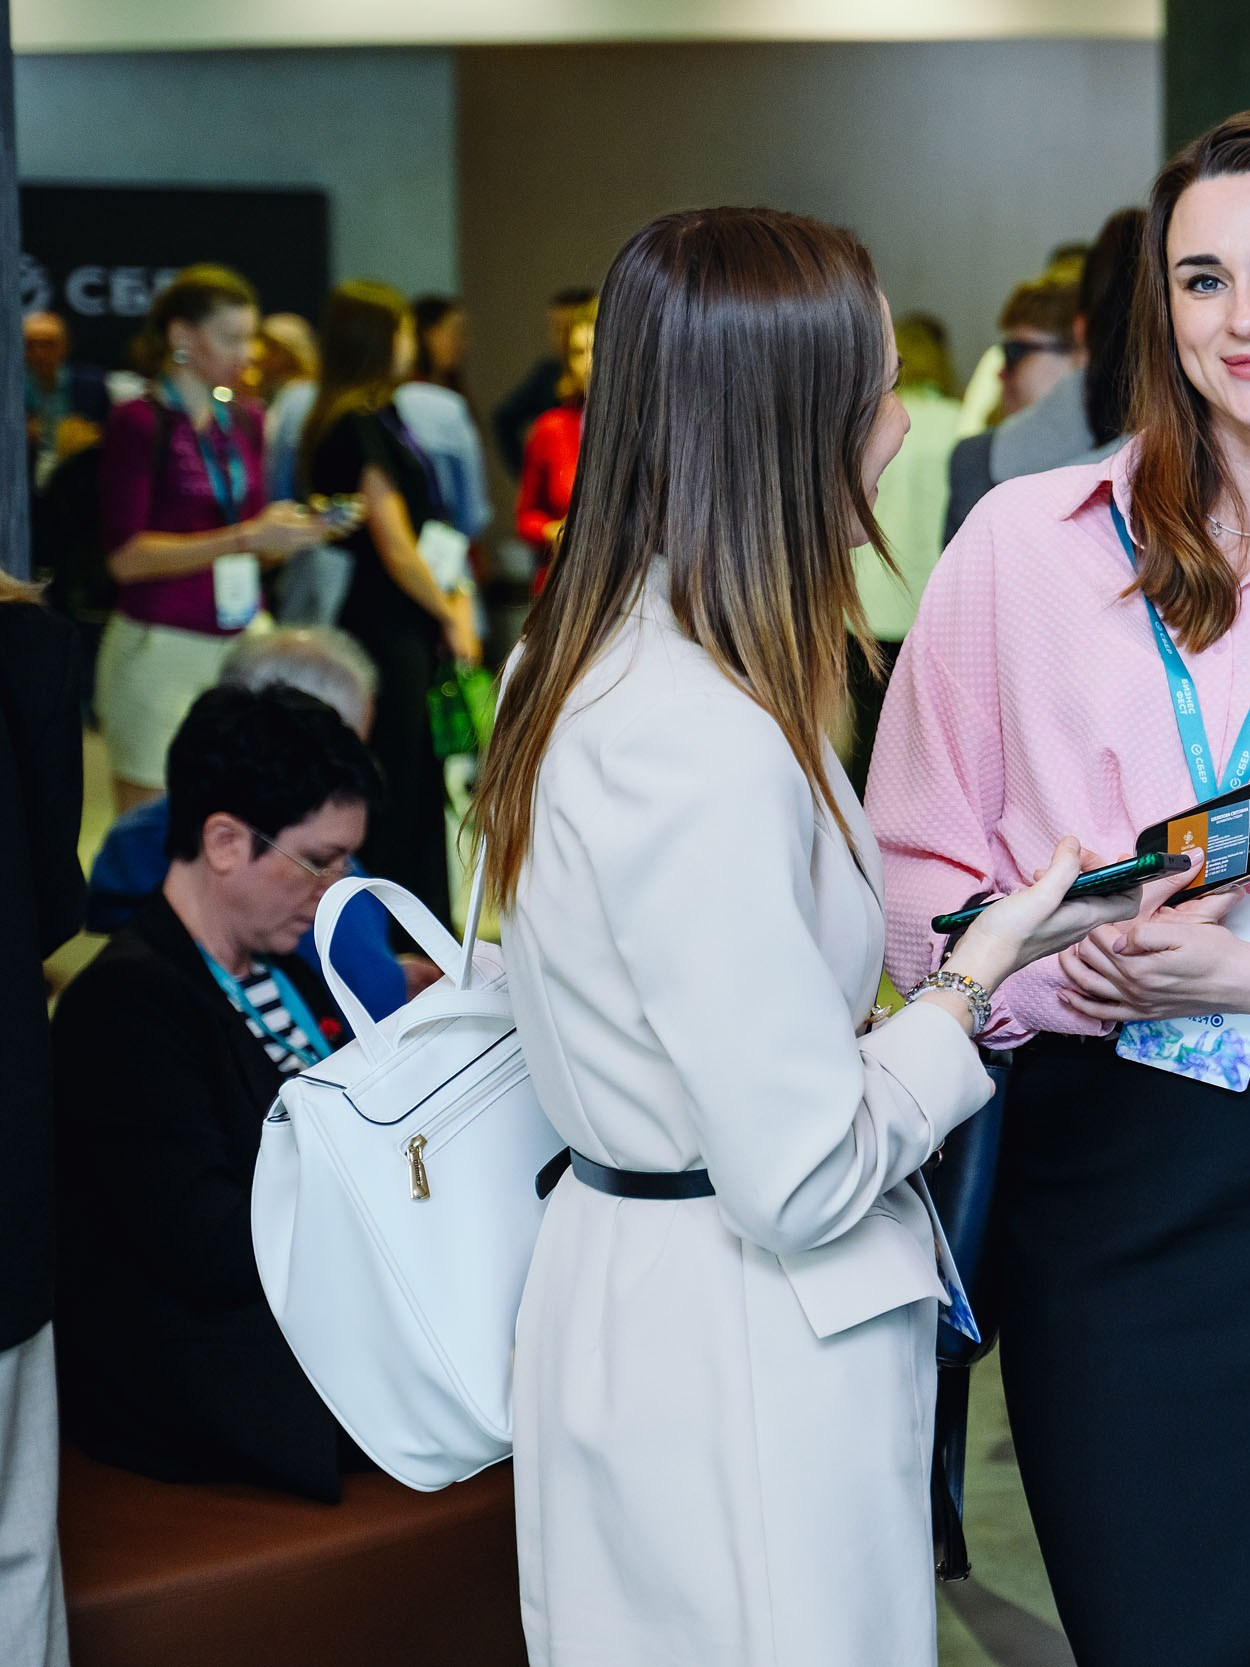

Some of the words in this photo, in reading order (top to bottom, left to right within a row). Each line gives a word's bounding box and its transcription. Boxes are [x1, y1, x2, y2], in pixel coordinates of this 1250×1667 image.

[1160, 632, 1172, 655] СБЕР
[1176, 690, 1188, 715] ФЕСТ
[1181, 678, 1196, 715] БИЗНЕС
[1195, 756, 1208, 784] СБЕР
[1236, 750, 1250, 777] СБЕР
